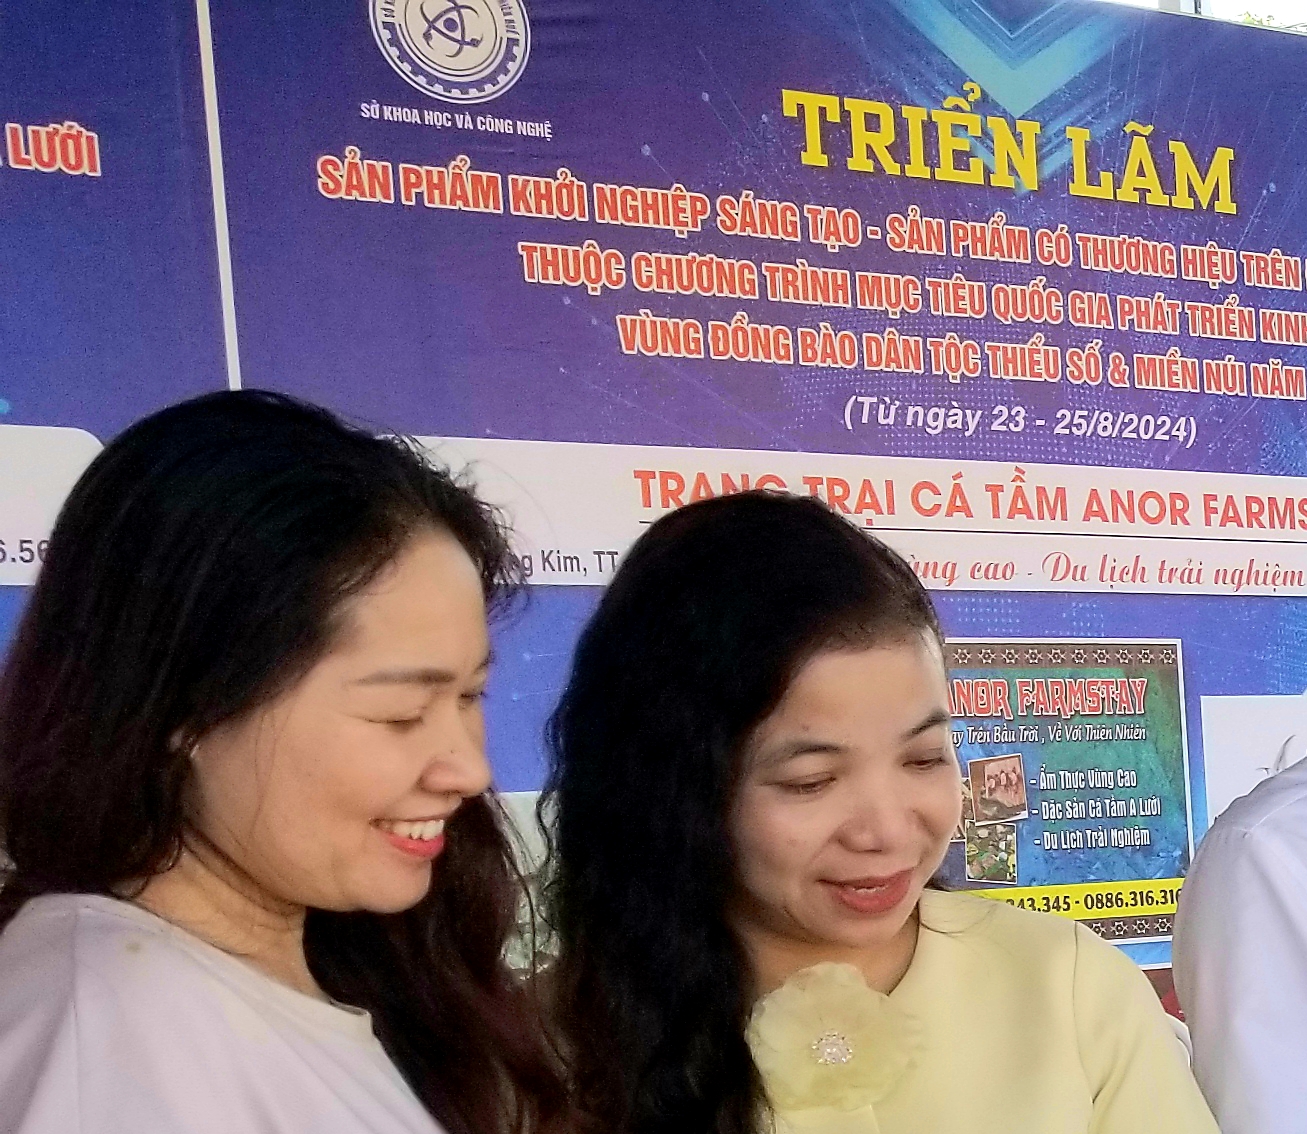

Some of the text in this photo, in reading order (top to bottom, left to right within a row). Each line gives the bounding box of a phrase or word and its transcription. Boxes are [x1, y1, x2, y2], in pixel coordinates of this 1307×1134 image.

[360, 100, 553, 141] SỞ KHOA HỌC VÀ CÔNG NGHỆ
[5, 120, 102, 176] LƯỚI
[781, 82, 1238, 215] TRIỂN LÃM
[316, 146, 394, 203] SẢN
[399, 154, 503, 214] PHẨM
[508, 168, 589, 222] KHỞI
[593, 183, 709, 238] NGHIỆP
[715, 190, 799, 242] SÁNG
[804, 202, 862, 252] TẠO
[886, 204, 946, 256] SẢN
[951, 210, 1031, 264] PHẨM
[1035, 224, 1072, 267] CÓ
[1077, 233, 1177, 278] THƯƠNG
[1181, 244, 1237, 291] HIỆU
[1241, 250, 1300, 292] TRÊN
[518, 240, 626, 295] THUỘC
[631, 251, 759, 300] CHƯƠNG
[762, 259, 852, 307] TRÌNH
[856, 271, 922, 317] MỤC
[926, 274, 985, 317] TIÊU
[992, 277, 1063, 324] QUỐC
[1068, 290, 1114, 330] GIA
[1118, 293, 1182, 337] PHÁT
[1187, 294, 1255, 342] TRIỂN
[616, 309, 702, 358] VÙNG
[708, 312, 793, 364] ĐỒNG
[798, 320, 859, 368] BÀO
[863, 329, 924, 374] DÂN
[927, 332, 982, 384] TỘC
[985, 333, 1061, 382] THIỂU
[1066, 341, 1102, 387] SỐ
[1107, 356, 1129, 389] &
[1133, 347, 1199, 393] MIỀN
[1203, 355, 1246, 396] NÚI
[1250, 362, 1307, 401] NĂM
[843, 394, 900, 430] (Từ
[906, 402, 983, 437] ngày
[991, 404, 1026, 433] 23
[1053, 408, 1198, 449] 25/8/2024)
[803, 476, 895, 526] TRẠI
[911, 470, 974, 519] CÁ
[985, 466, 1068, 523] TẦM
[1082, 487, 1191, 527] ANOR
[540, 549, 588, 577] Kim,
[969, 561, 1018, 581] cao
[1041, 551, 1088, 583] Du
[1099, 553, 1147, 589] lịch
[1157, 558, 1204, 585] trải
[1213, 558, 1306, 592] nghiệm
[1016, 678, 1148, 720] FARMSTAY
[967, 725, 991, 744] Trên
[993, 723, 1016, 743] Bầu
[1018, 725, 1039, 742] Trời
[1064, 724, 1082, 742] Với
[1085, 723, 1113, 741] Thiên
[1115, 723, 1147, 741] Nhiên
[1059, 770, 1086, 794] Thực
[1087, 768, 1115, 790] Vùng
[1117, 769, 1138, 788] Cao
[1041, 799, 1063, 823] Đặc
[1065, 796, 1086, 819] Sản
[1088, 796, 1102, 819] Cá
[1104, 794, 1126, 817] Tầm
[1129, 799, 1137, 817] A
[1043, 831, 1058, 850] Du
[1110, 828, 1151, 850] Nghiệm
